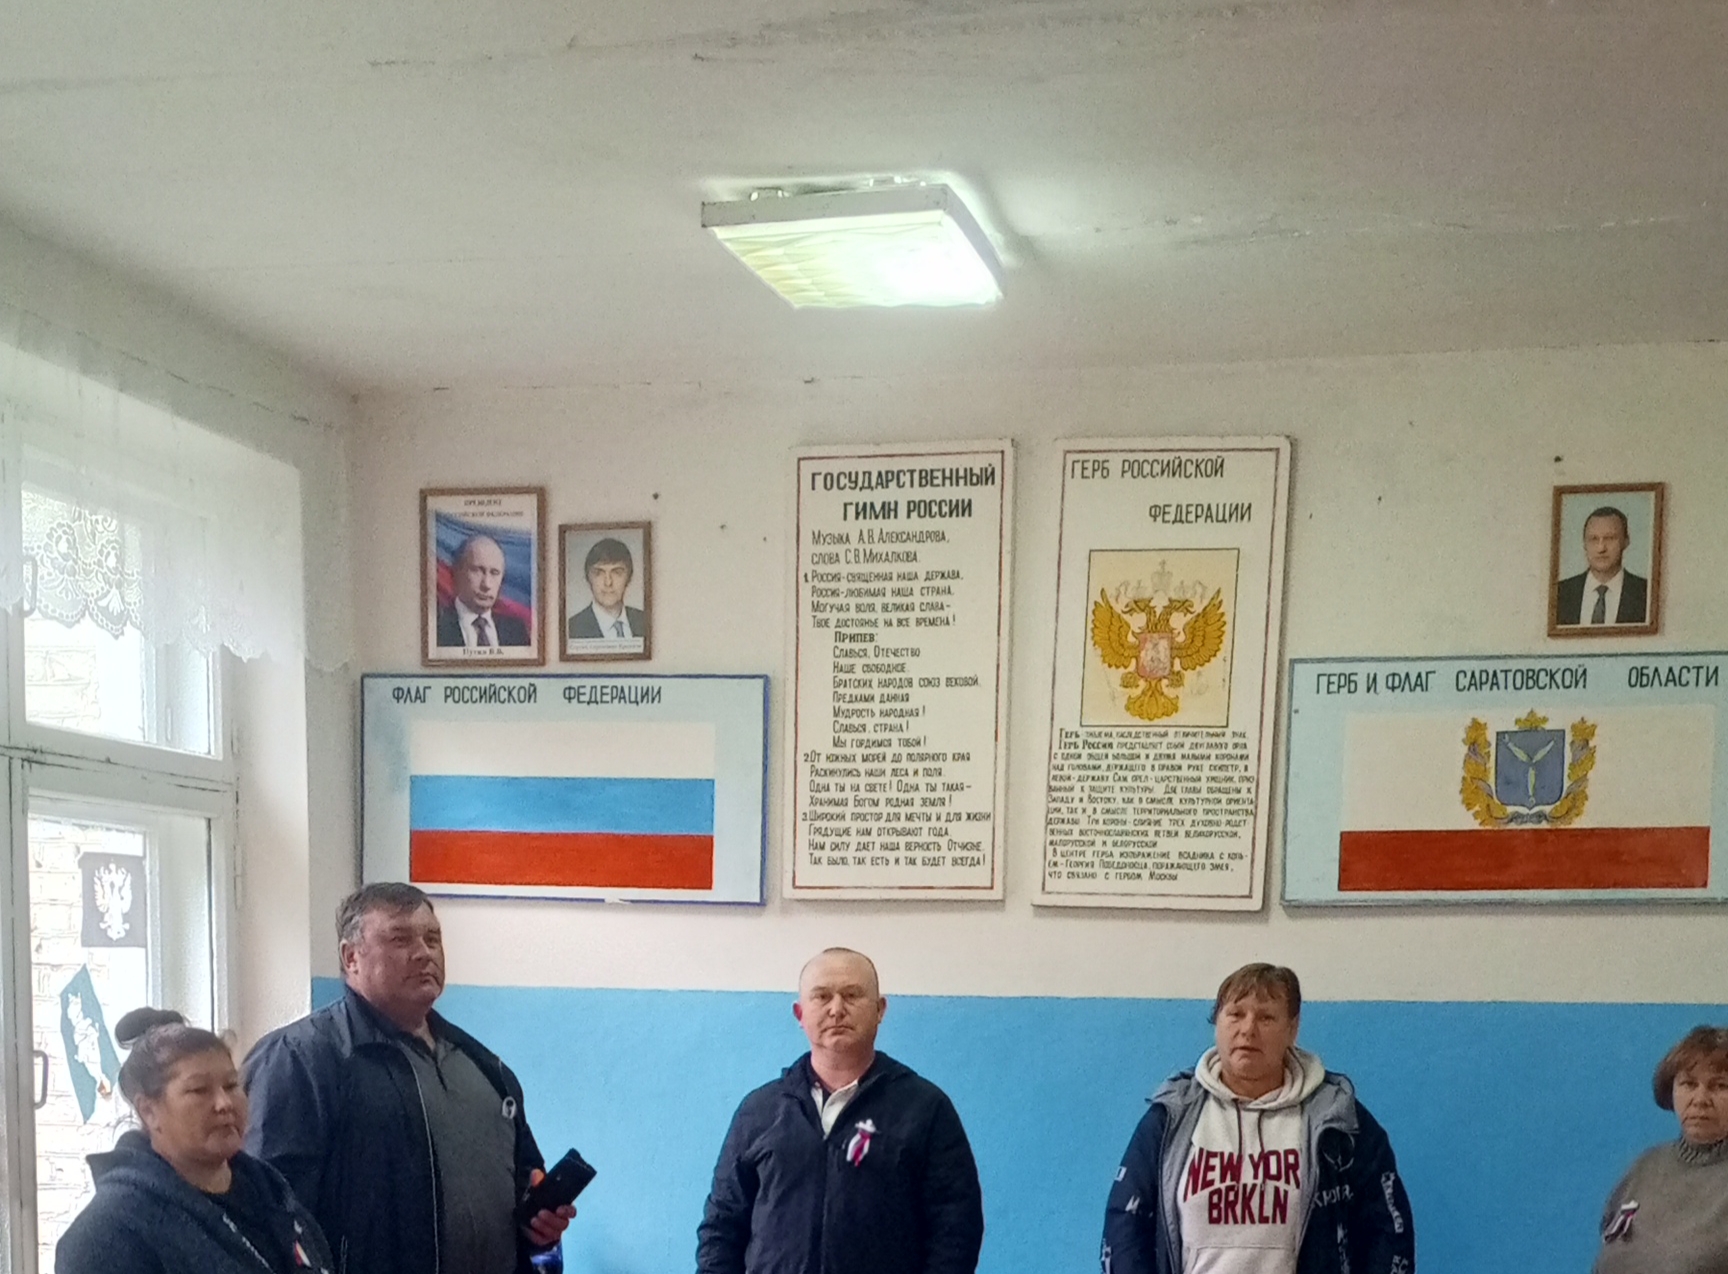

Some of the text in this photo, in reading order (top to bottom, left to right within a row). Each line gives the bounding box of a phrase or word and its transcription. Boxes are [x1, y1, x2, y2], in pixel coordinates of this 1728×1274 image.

[811, 463, 996, 491] ГОСУДАРСТВЕННЫЙ
[1071, 455, 1225, 479] ГЕРБ РОССИЙСКОЙ
[843, 499, 973, 521] ГИМН РОССИИ
[1149, 502, 1252, 525] ФЕДЕРАЦИИ
[1316, 664, 1720, 695] ГЕРБ И ФЛАГ САРАТОВСКОЙ ОБЛАСТИ
[392, 682, 662, 707] ФЛАГ РОССИЙСКОЙ ФЕДЕРАЦИИ
[1183, 1146, 1300, 1203] NEW YOR
[1208, 1182, 1288, 1224] BRKLN
